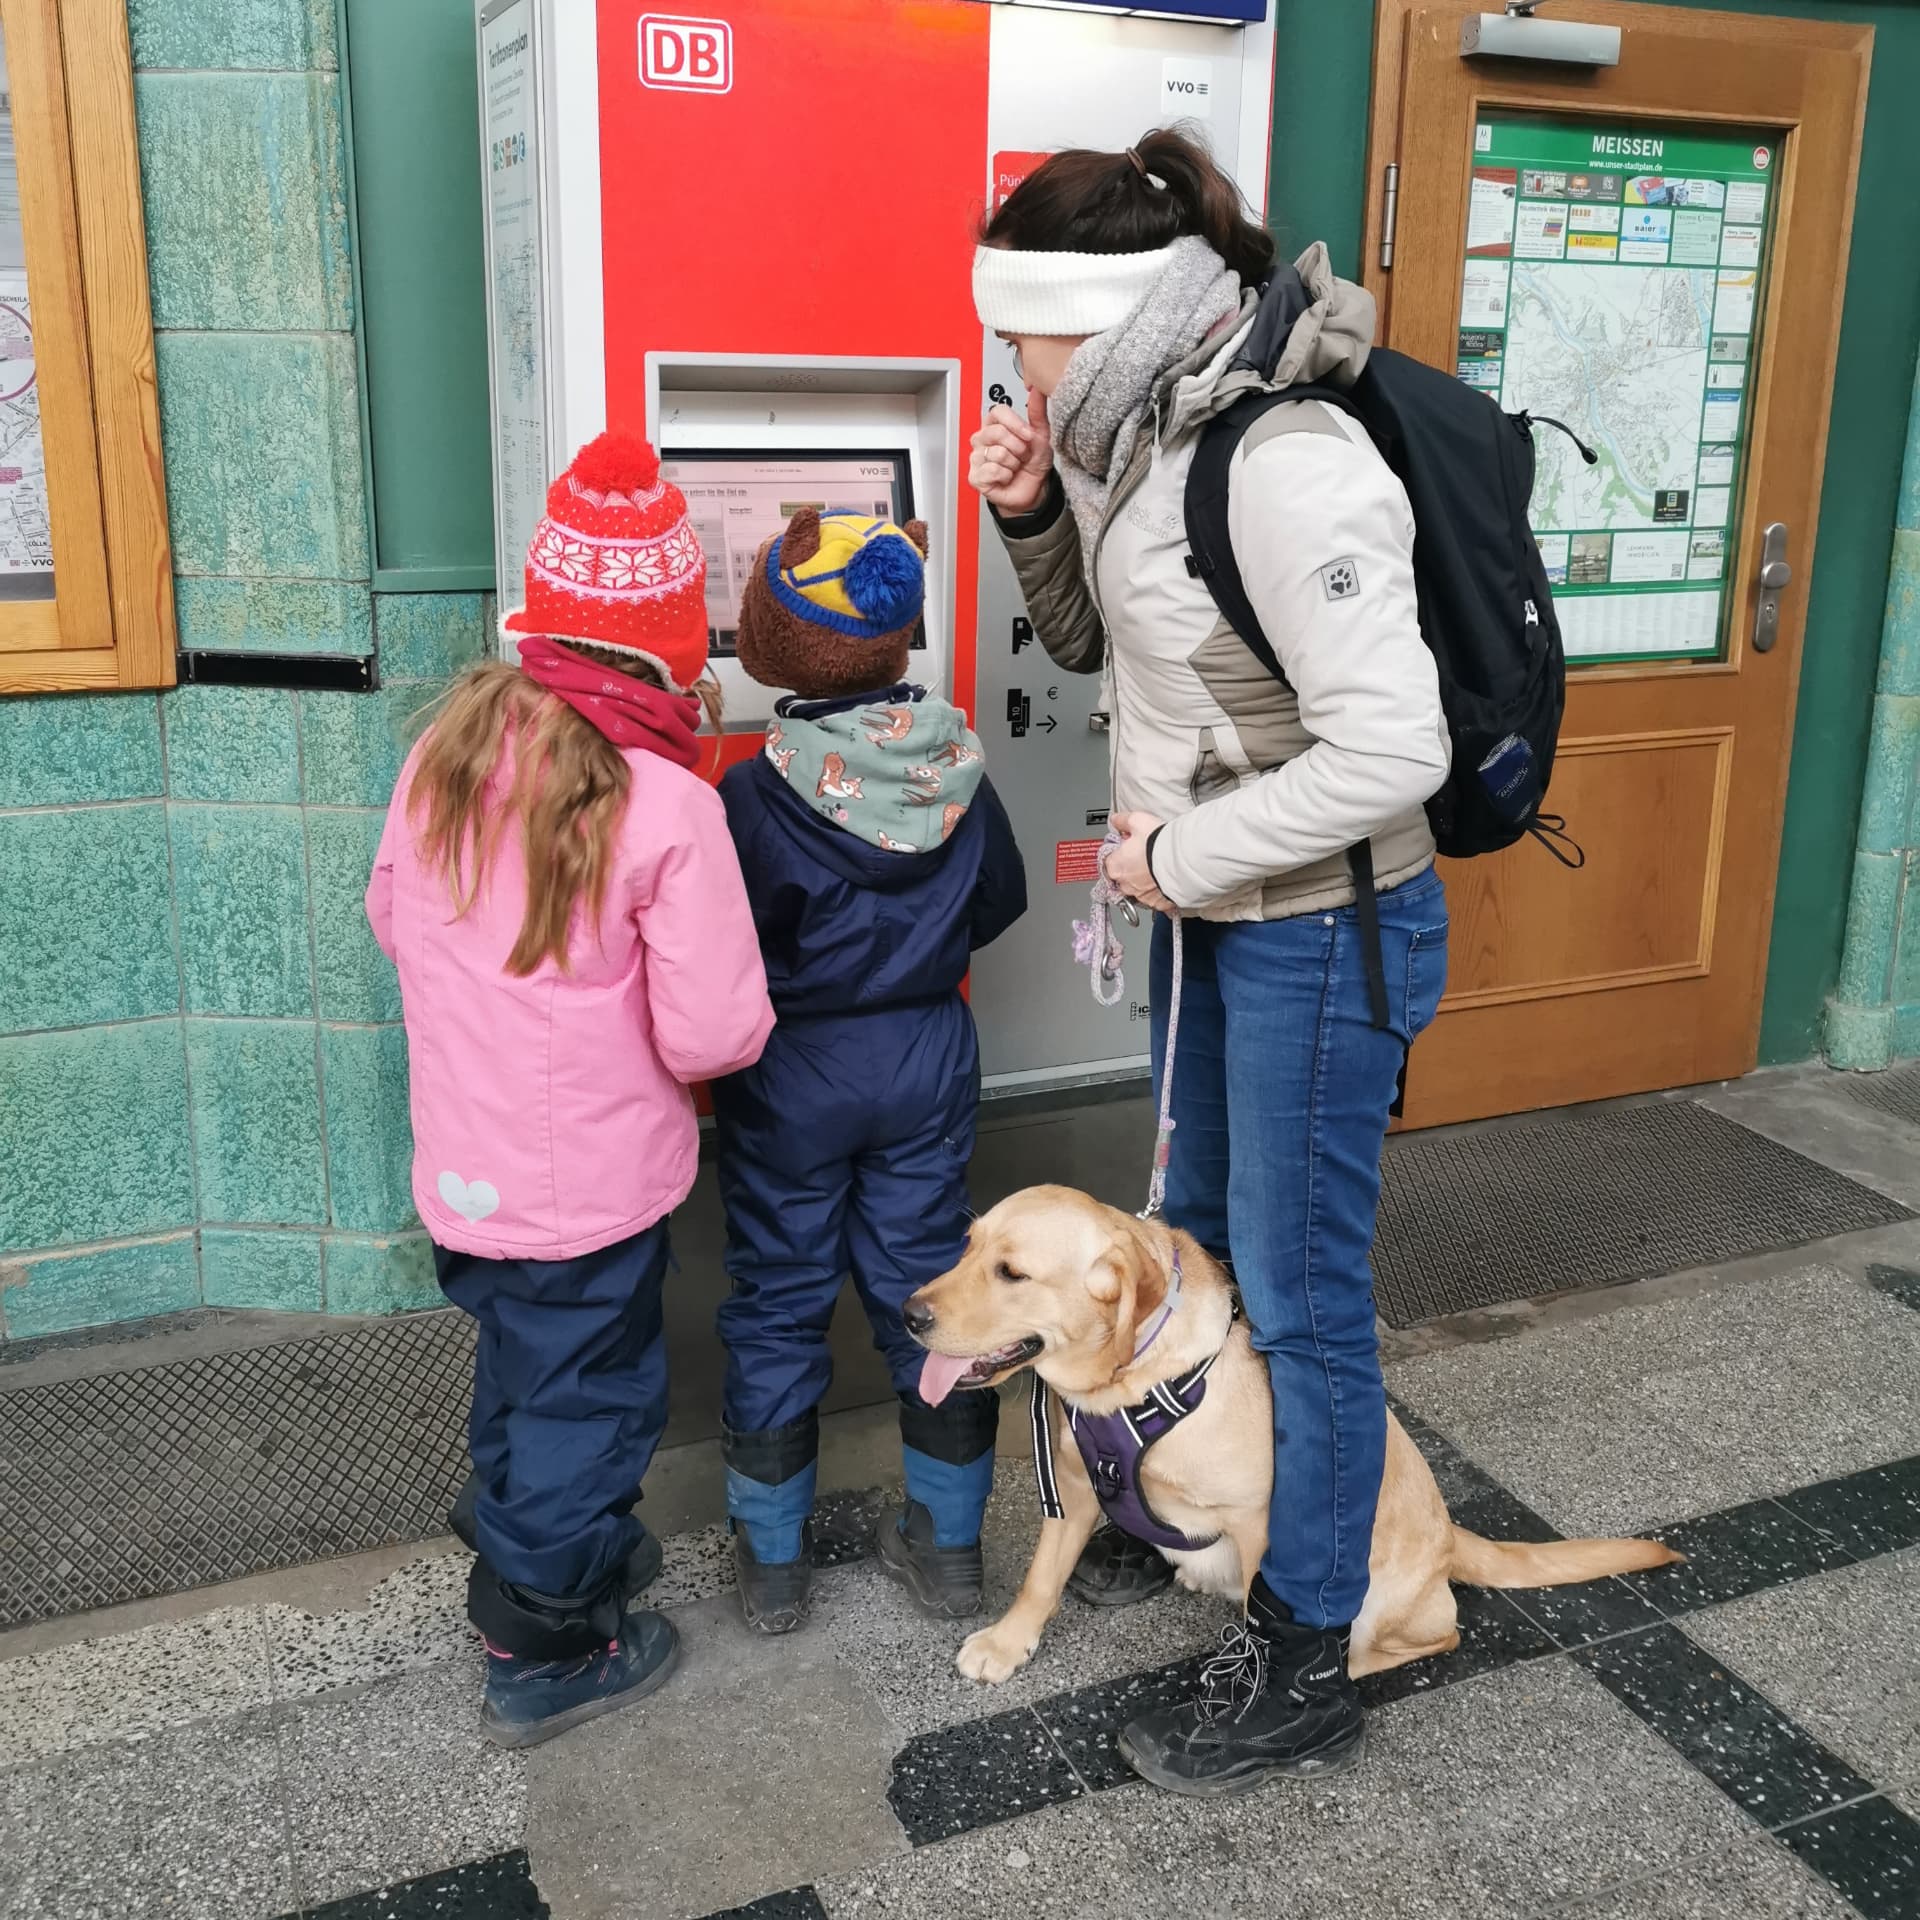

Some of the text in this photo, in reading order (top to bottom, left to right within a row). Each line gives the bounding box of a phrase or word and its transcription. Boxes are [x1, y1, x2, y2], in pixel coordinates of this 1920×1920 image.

[652, 28, 720, 78] DB
[1166, 80, 1195, 94] VVO
[1592, 135, 1664, 157] MEISSEN
[1588, 160, 1663, 172] www.unser-stadtplan.de
[859, 467, 880, 476] VVO
[31, 558, 54, 568] VVO
[1309, 1666, 1339, 1681] LOWA
